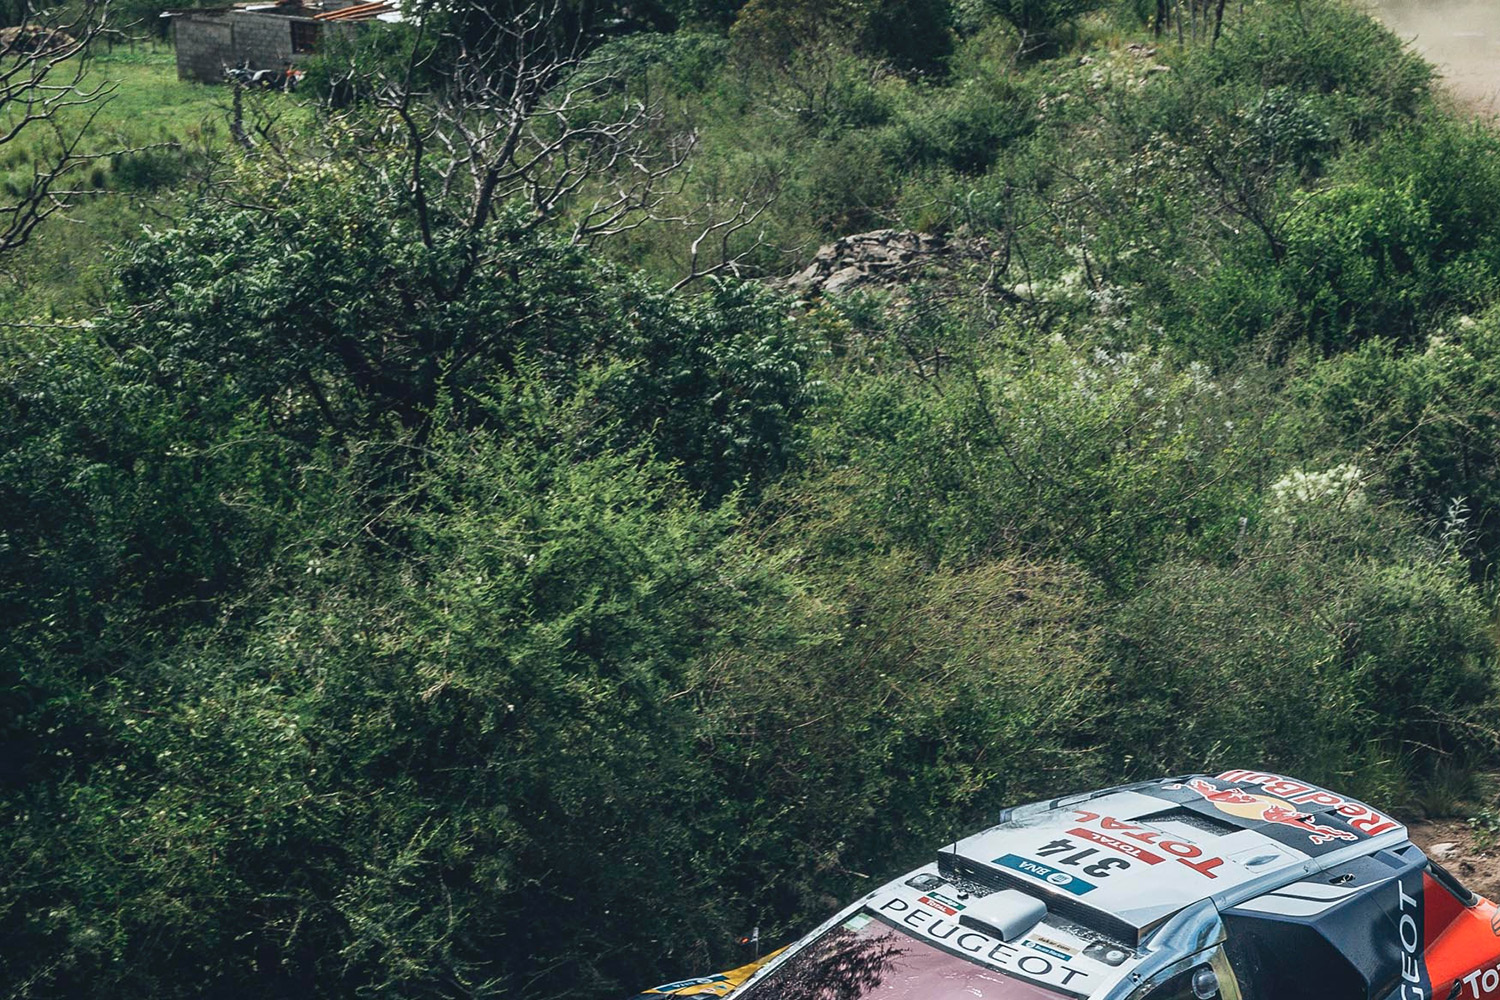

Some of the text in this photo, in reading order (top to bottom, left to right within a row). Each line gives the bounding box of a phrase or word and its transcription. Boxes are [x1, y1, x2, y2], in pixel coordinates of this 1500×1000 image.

[1035, 838, 1131, 878] 314
[1073, 811, 1224, 879] TOTAL
[1092, 833, 1140, 857] TOTAL
[1018, 861, 1052, 875] BNA
[879, 897, 1089, 985] PEUGEOT
